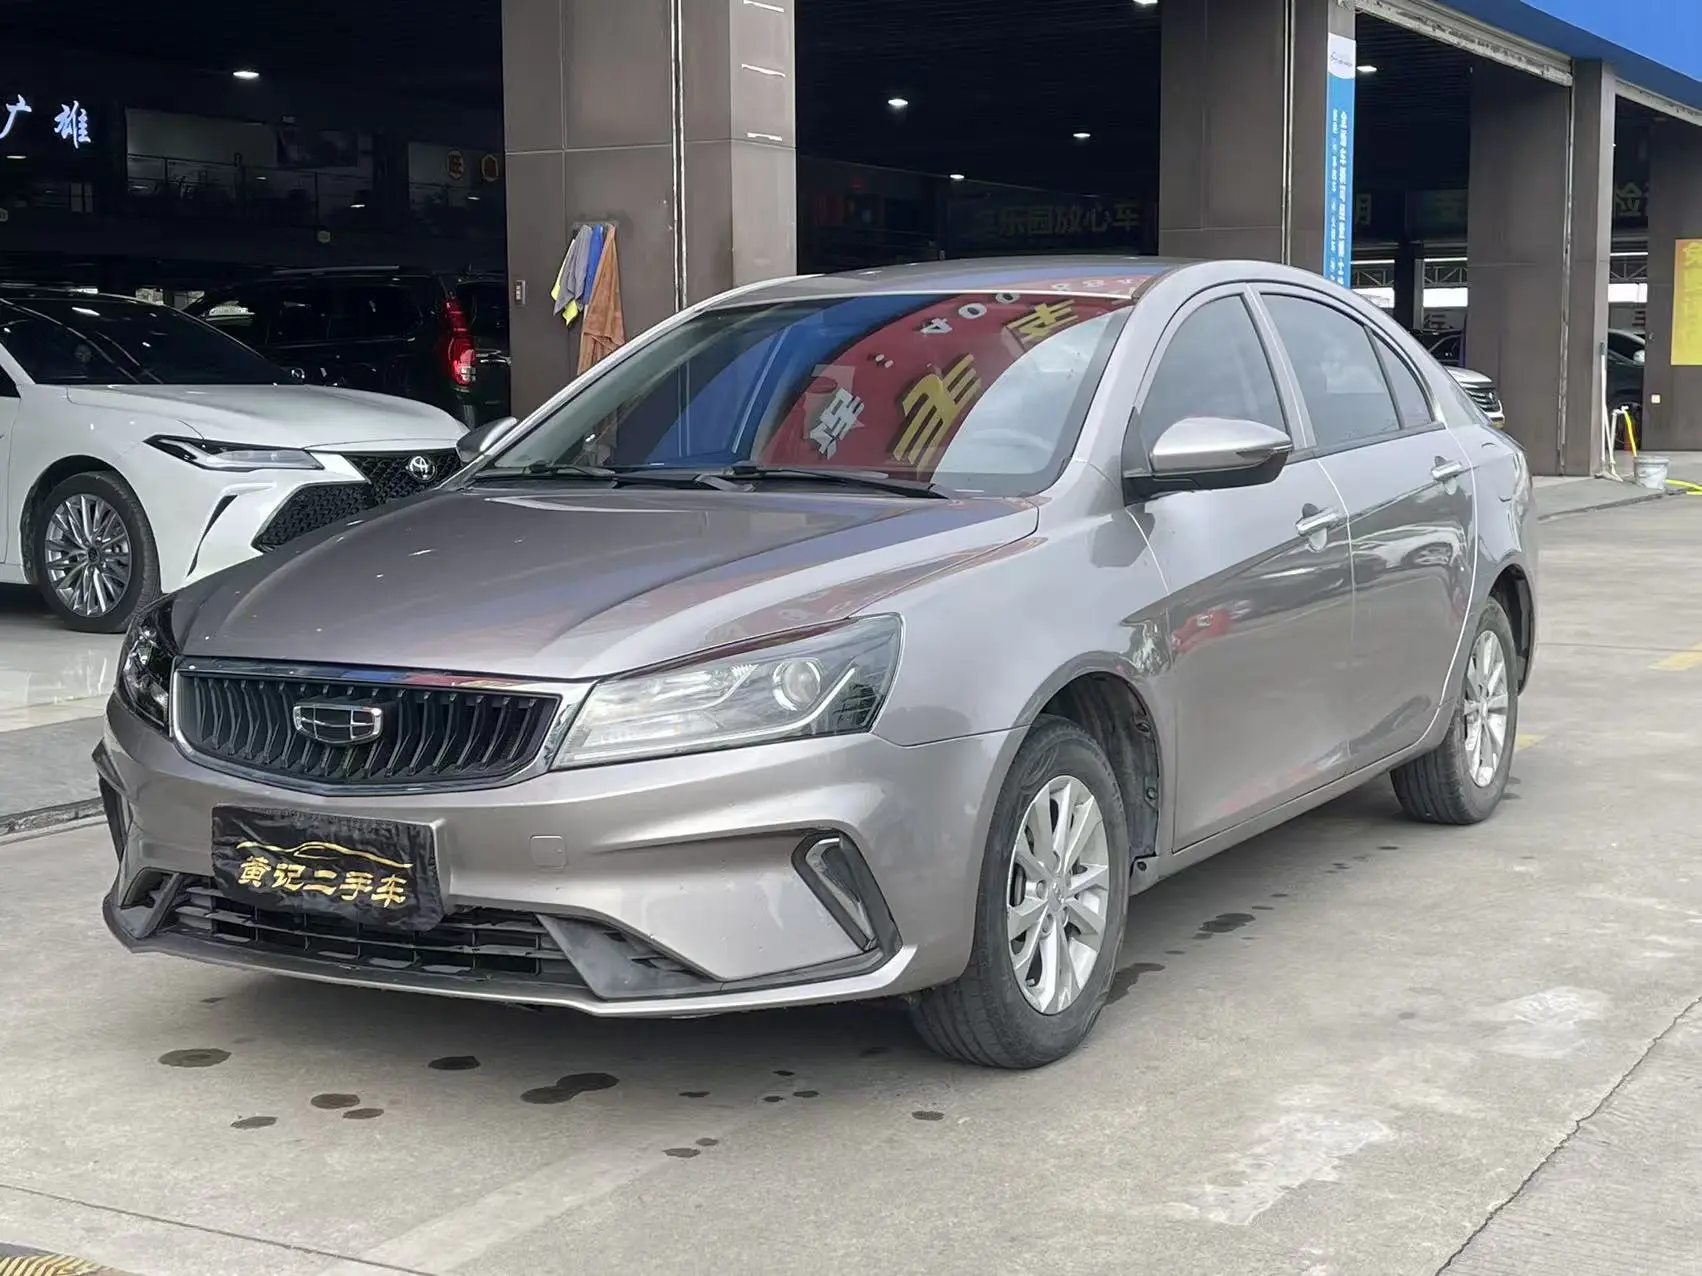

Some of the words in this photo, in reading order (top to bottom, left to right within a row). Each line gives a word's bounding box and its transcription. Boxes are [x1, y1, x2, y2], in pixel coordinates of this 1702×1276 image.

[976, 201, 1140, 238] 乐园放心车
[238, 856, 407, 908] 黄记二手车
